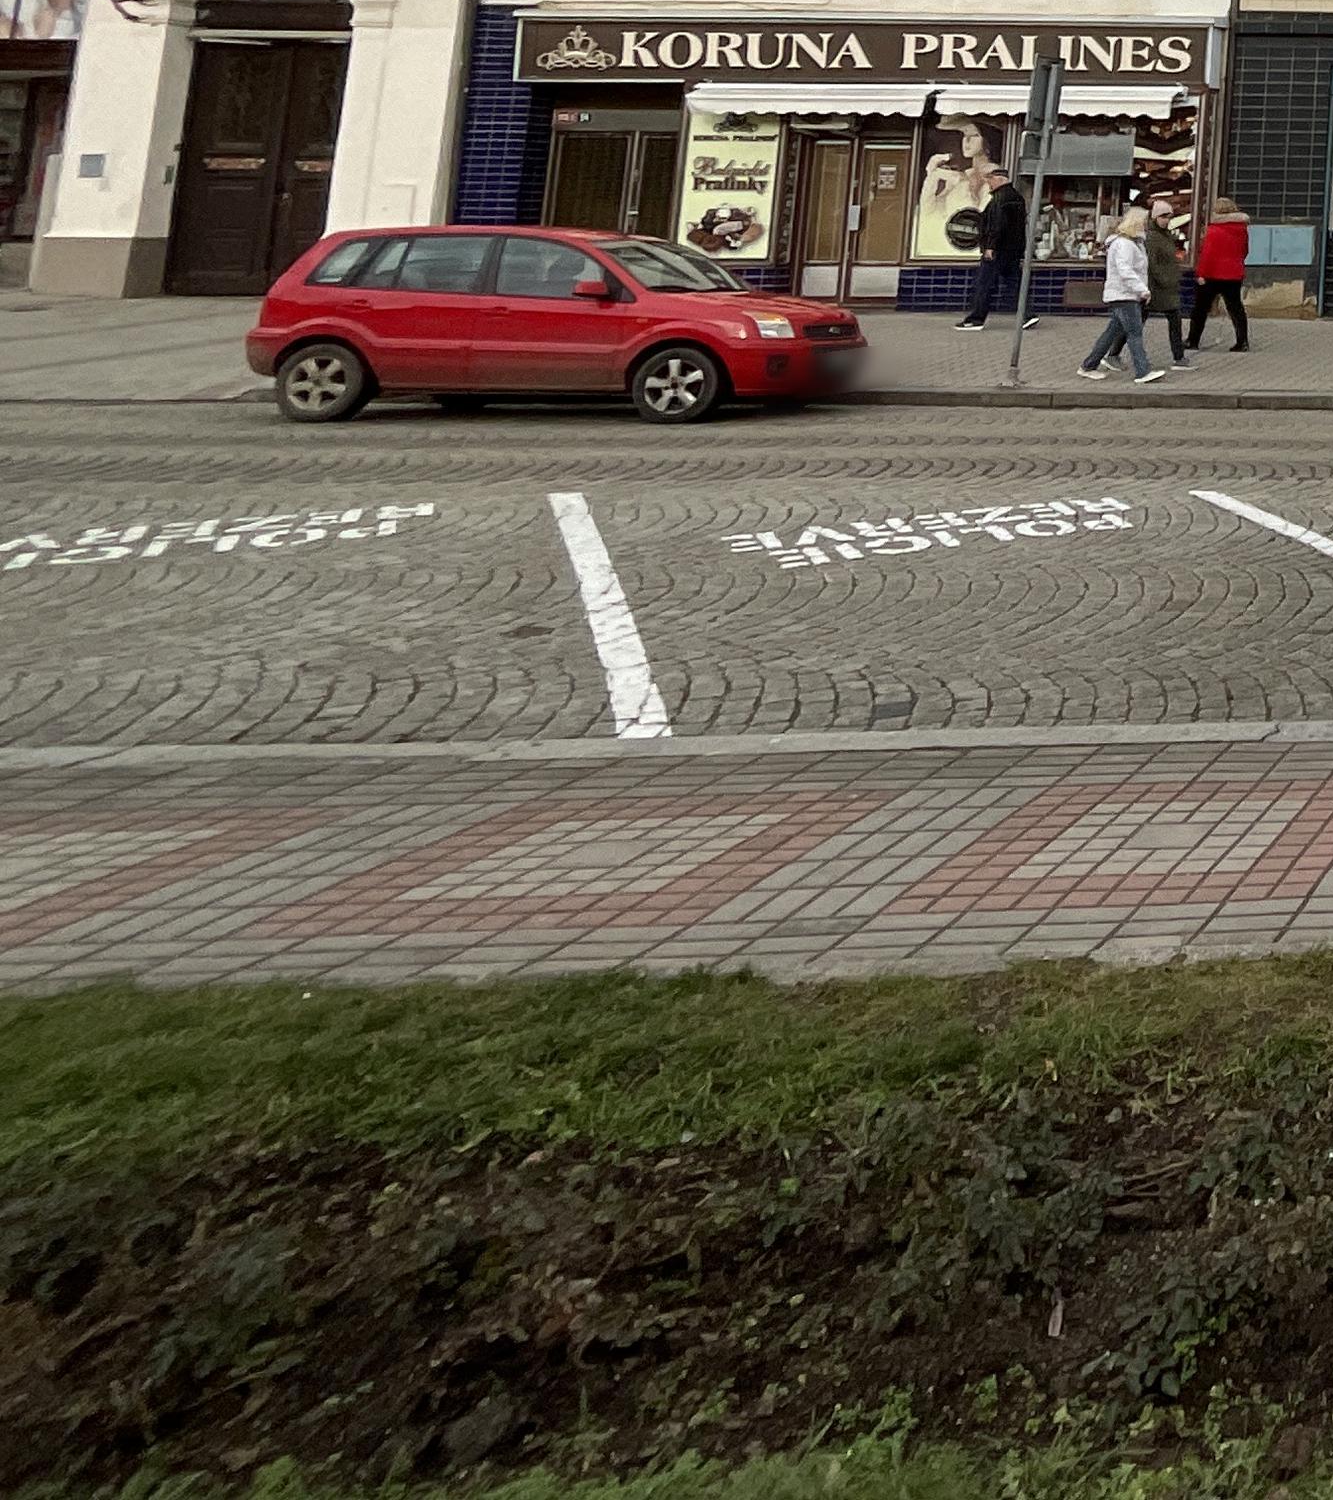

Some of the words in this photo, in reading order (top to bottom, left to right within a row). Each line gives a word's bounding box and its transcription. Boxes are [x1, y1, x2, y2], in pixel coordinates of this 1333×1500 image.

[618, 31, 873, 69] KORUNA
[720, 497, 1132, 553] REZERVE
[769, 514, 1134, 570] POLICIE
